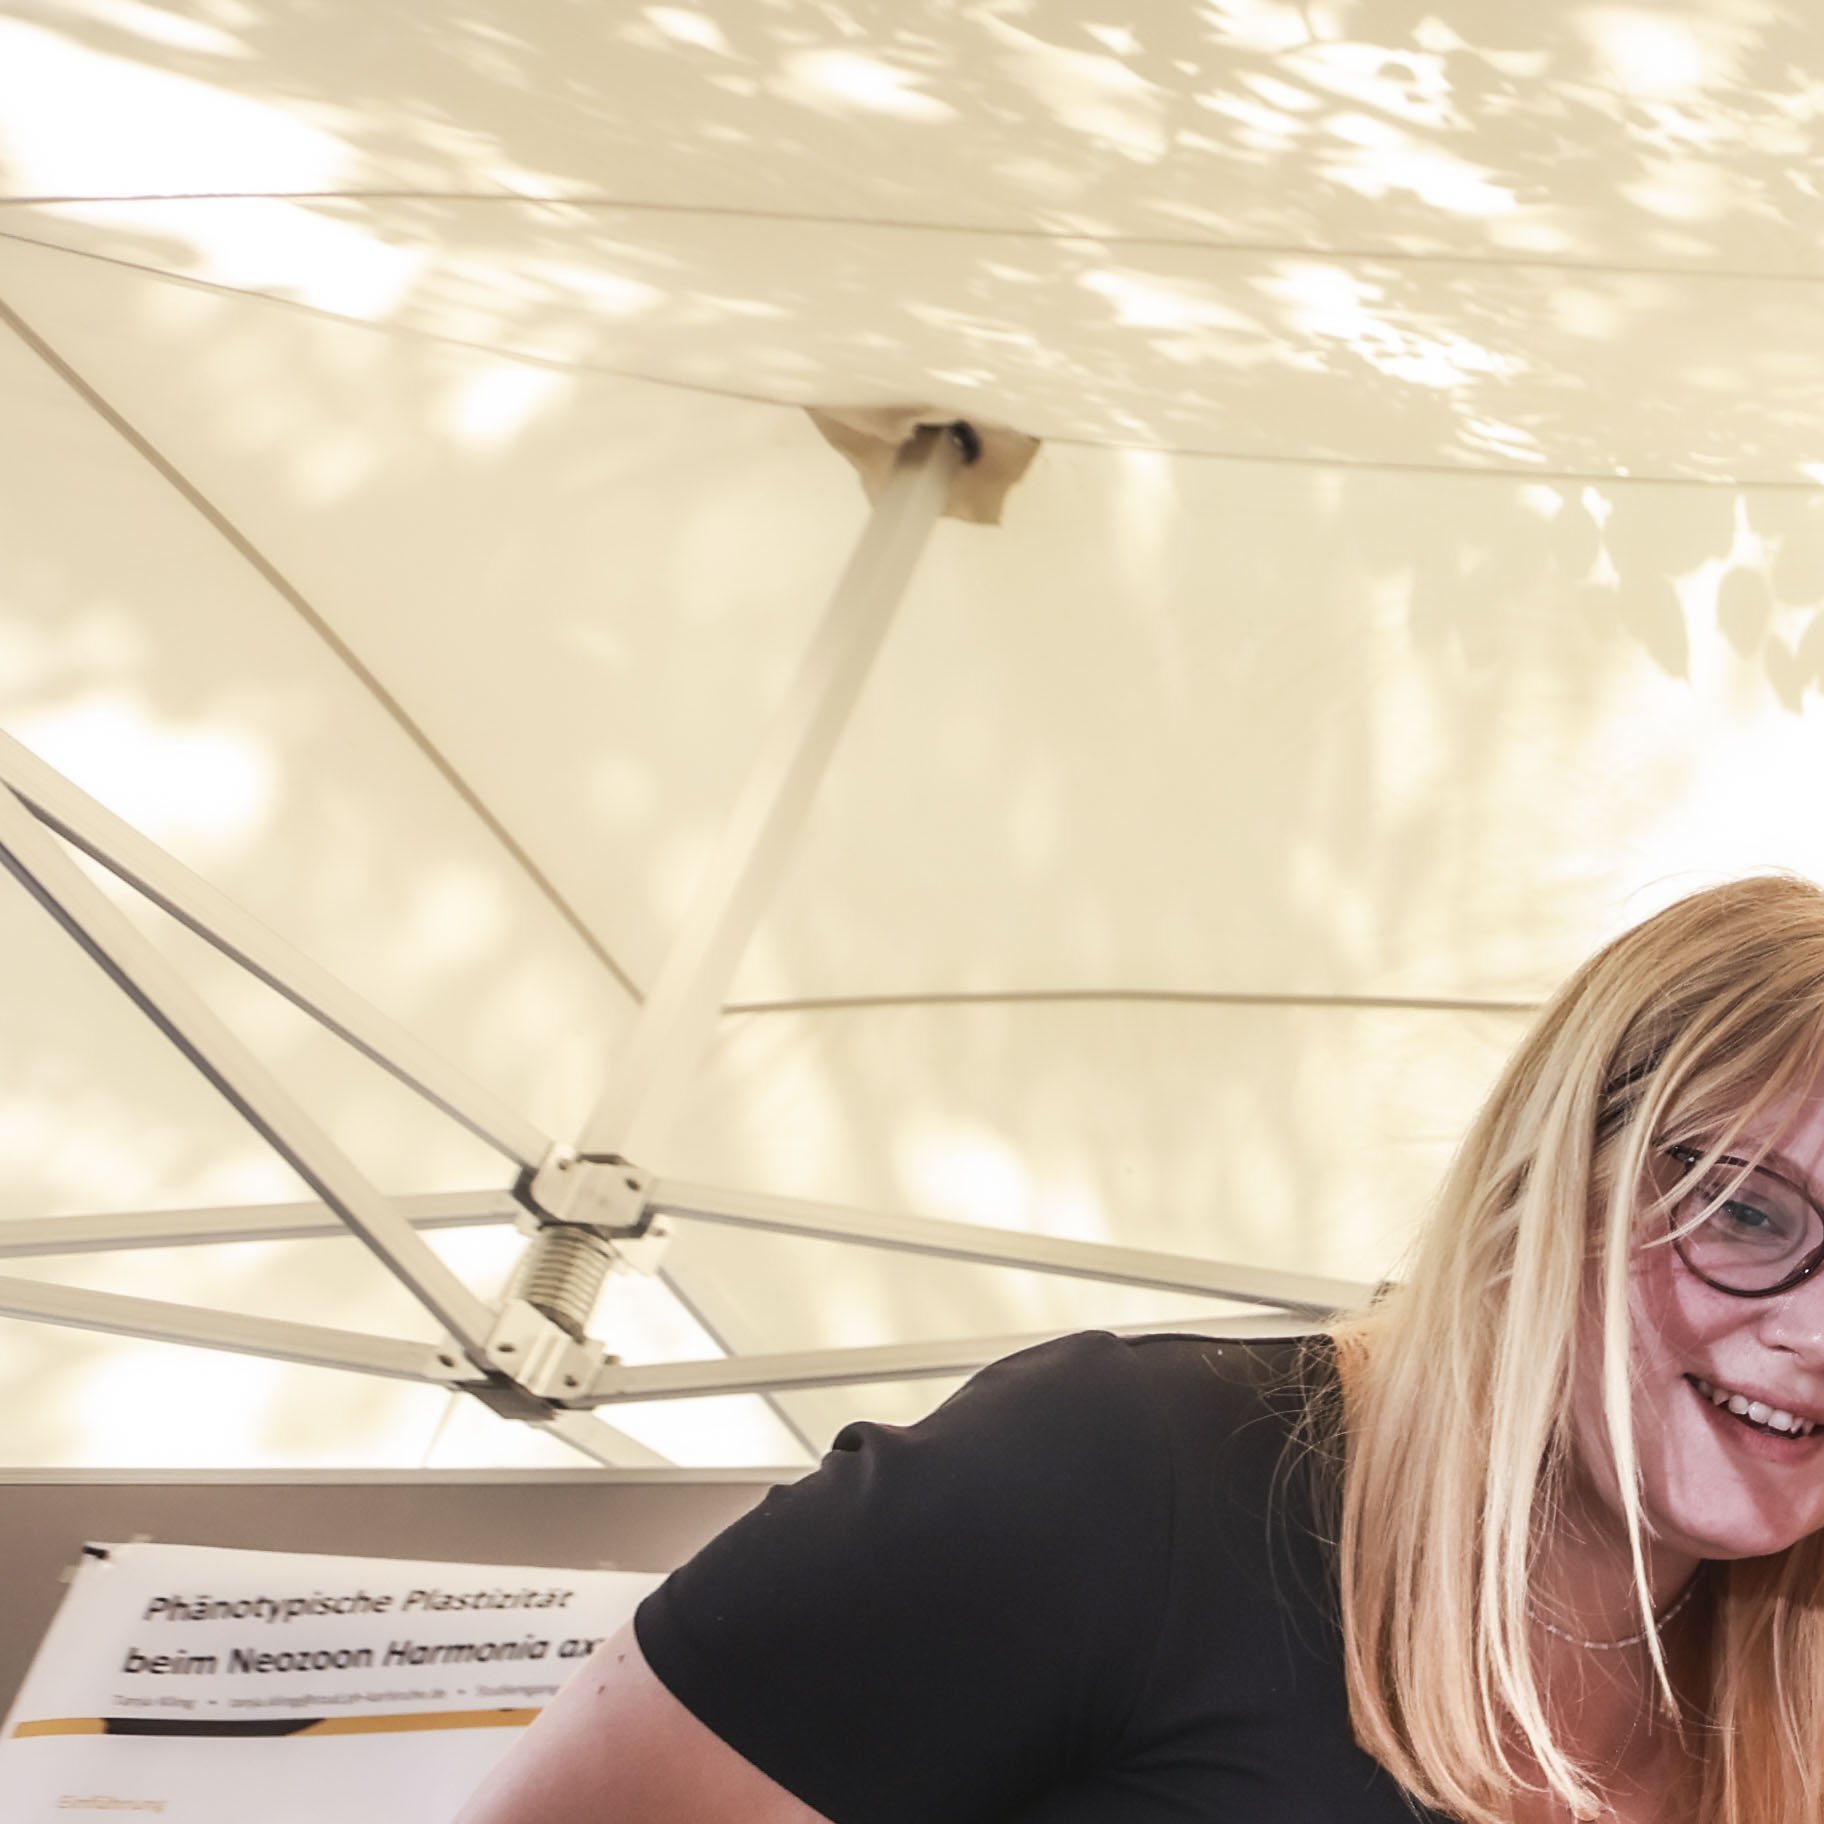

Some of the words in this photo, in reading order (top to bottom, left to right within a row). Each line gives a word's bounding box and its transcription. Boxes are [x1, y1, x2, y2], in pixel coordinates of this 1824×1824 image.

[142, 1591, 393, 1624] Phänotypische
[401, 1587, 574, 1613] Plastizität
[122, 1646, 218, 1675] beim
[226, 1646, 374, 1675] Neozoon
[382, 1634, 548, 1667] Harmonia
